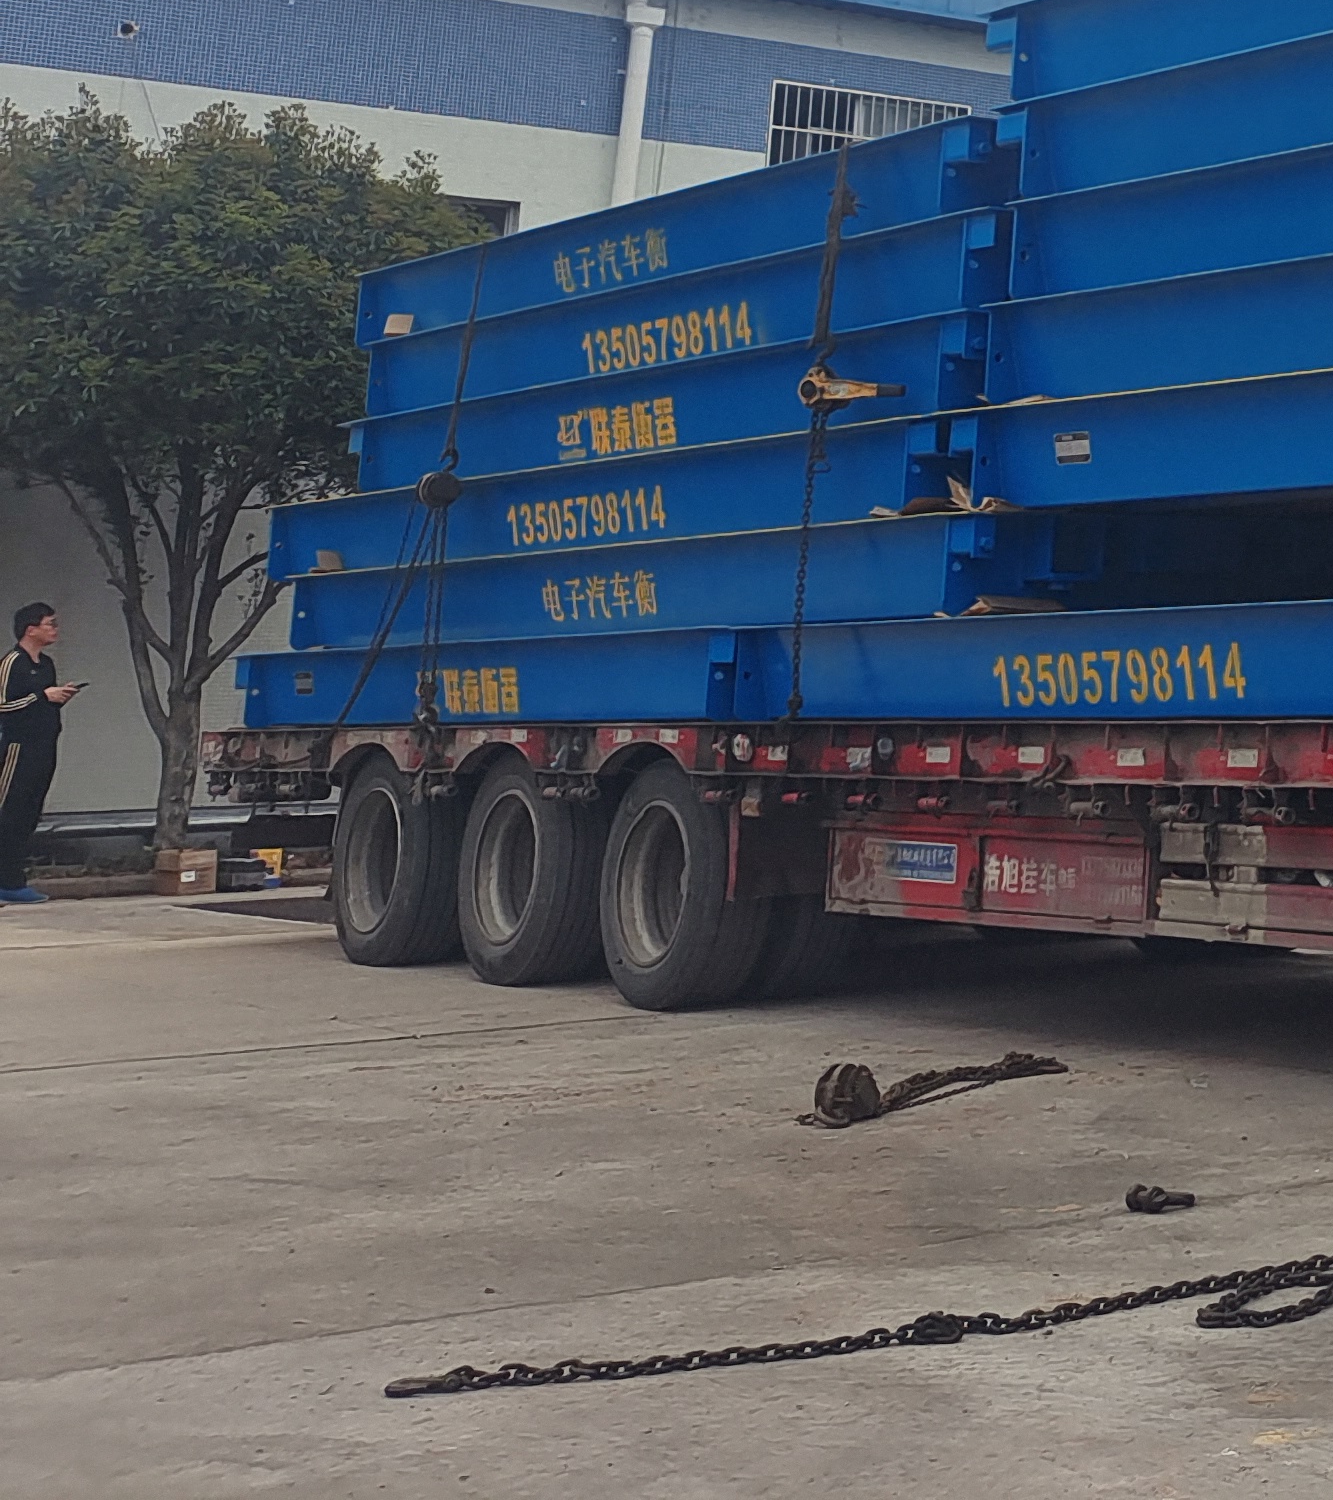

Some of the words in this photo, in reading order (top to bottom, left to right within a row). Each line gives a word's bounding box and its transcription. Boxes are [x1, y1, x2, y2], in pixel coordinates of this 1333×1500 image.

[553, 227, 668, 293] 电子汽车衡
[582, 301, 752, 375] 13505798114
[507, 485, 666, 547] 13505798114
[541, 569, 658, 621] 电子汽车衡
[993, 642, 1247, 707] 13505798114
